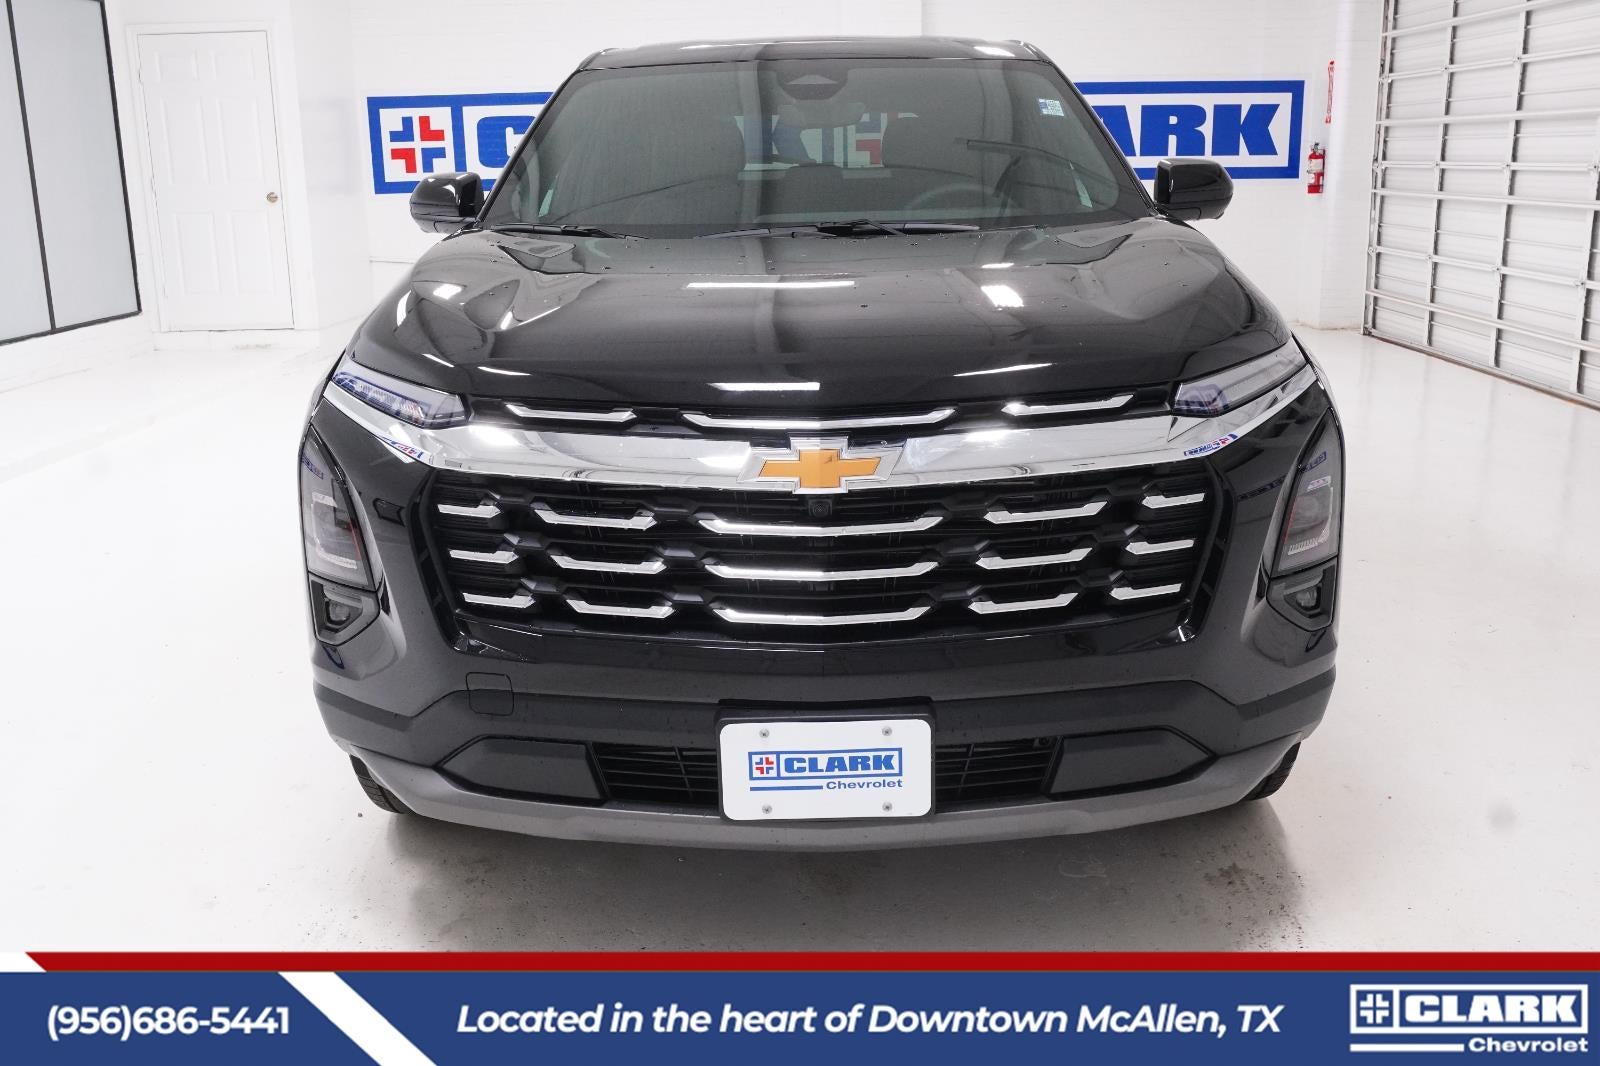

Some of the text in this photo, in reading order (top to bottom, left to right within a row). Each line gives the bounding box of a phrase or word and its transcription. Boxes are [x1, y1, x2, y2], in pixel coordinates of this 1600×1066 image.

[1092, 103, 1281, 157] ARK
[784, 754, 896, 774] CLARK
[826, 778, 903, 791] Chevrolet
